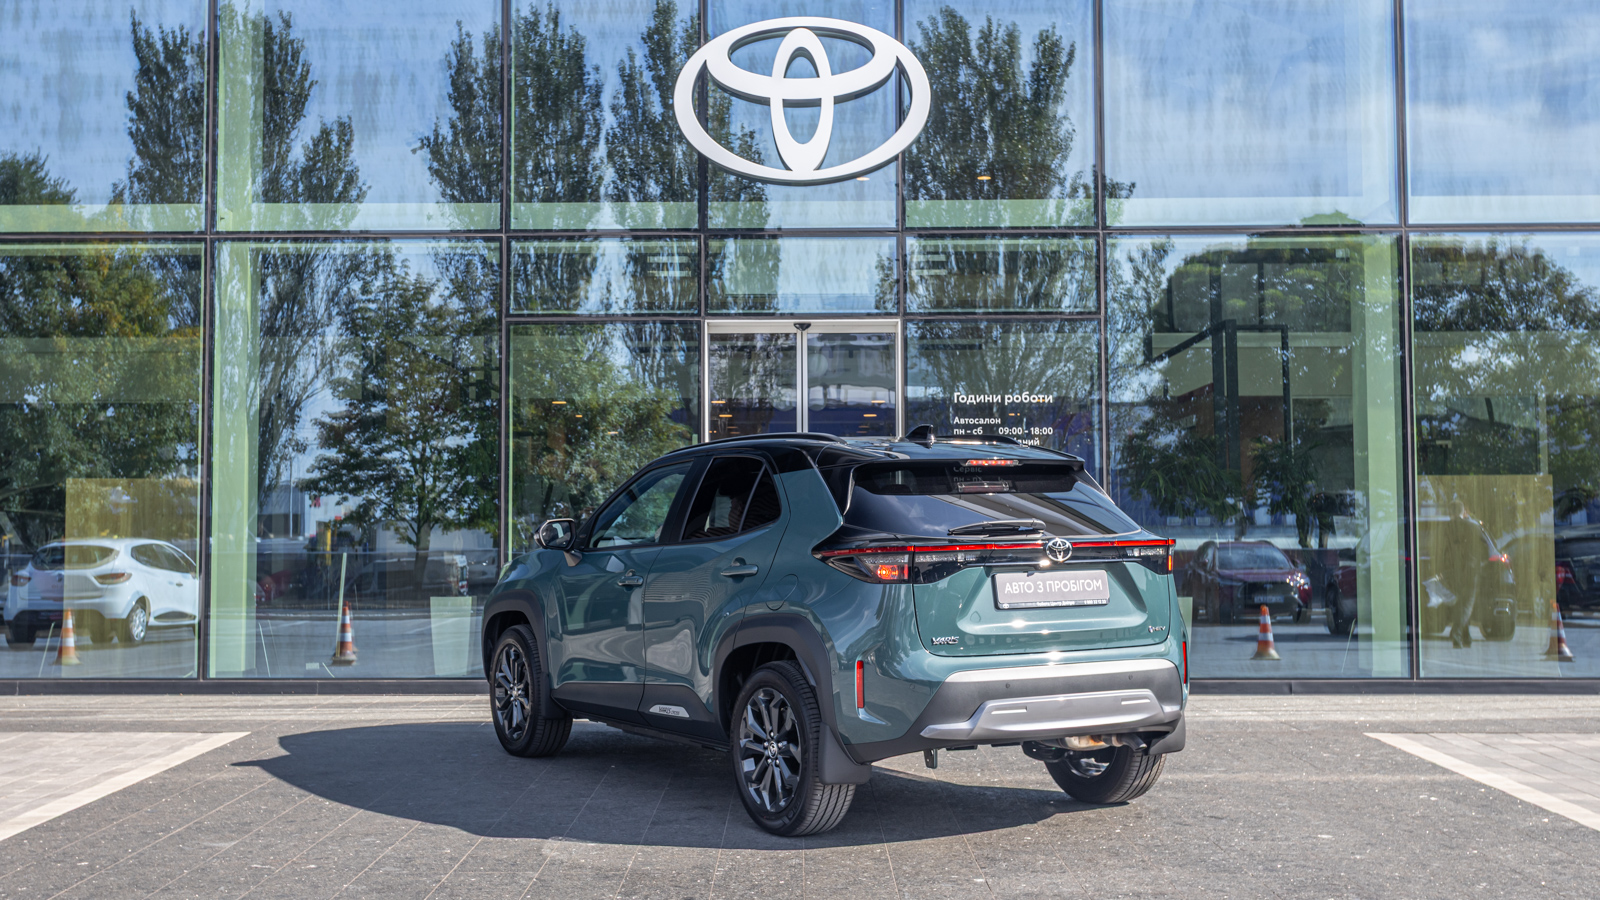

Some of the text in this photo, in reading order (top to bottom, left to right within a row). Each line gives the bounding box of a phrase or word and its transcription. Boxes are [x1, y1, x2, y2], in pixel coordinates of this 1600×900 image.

[953, 391, 1053, 405] Години роботи
[953, 416, 1001, 425] Автосалон
[972, 427, 983, 435] сб
[998, 427, 1023, 435] 09:00
[1030, 427, 1053, 435] 18:00
[1004, 581, 1035, 594] АВТО
[1046, 579, 1103, 593] ПРОБІГОМ
